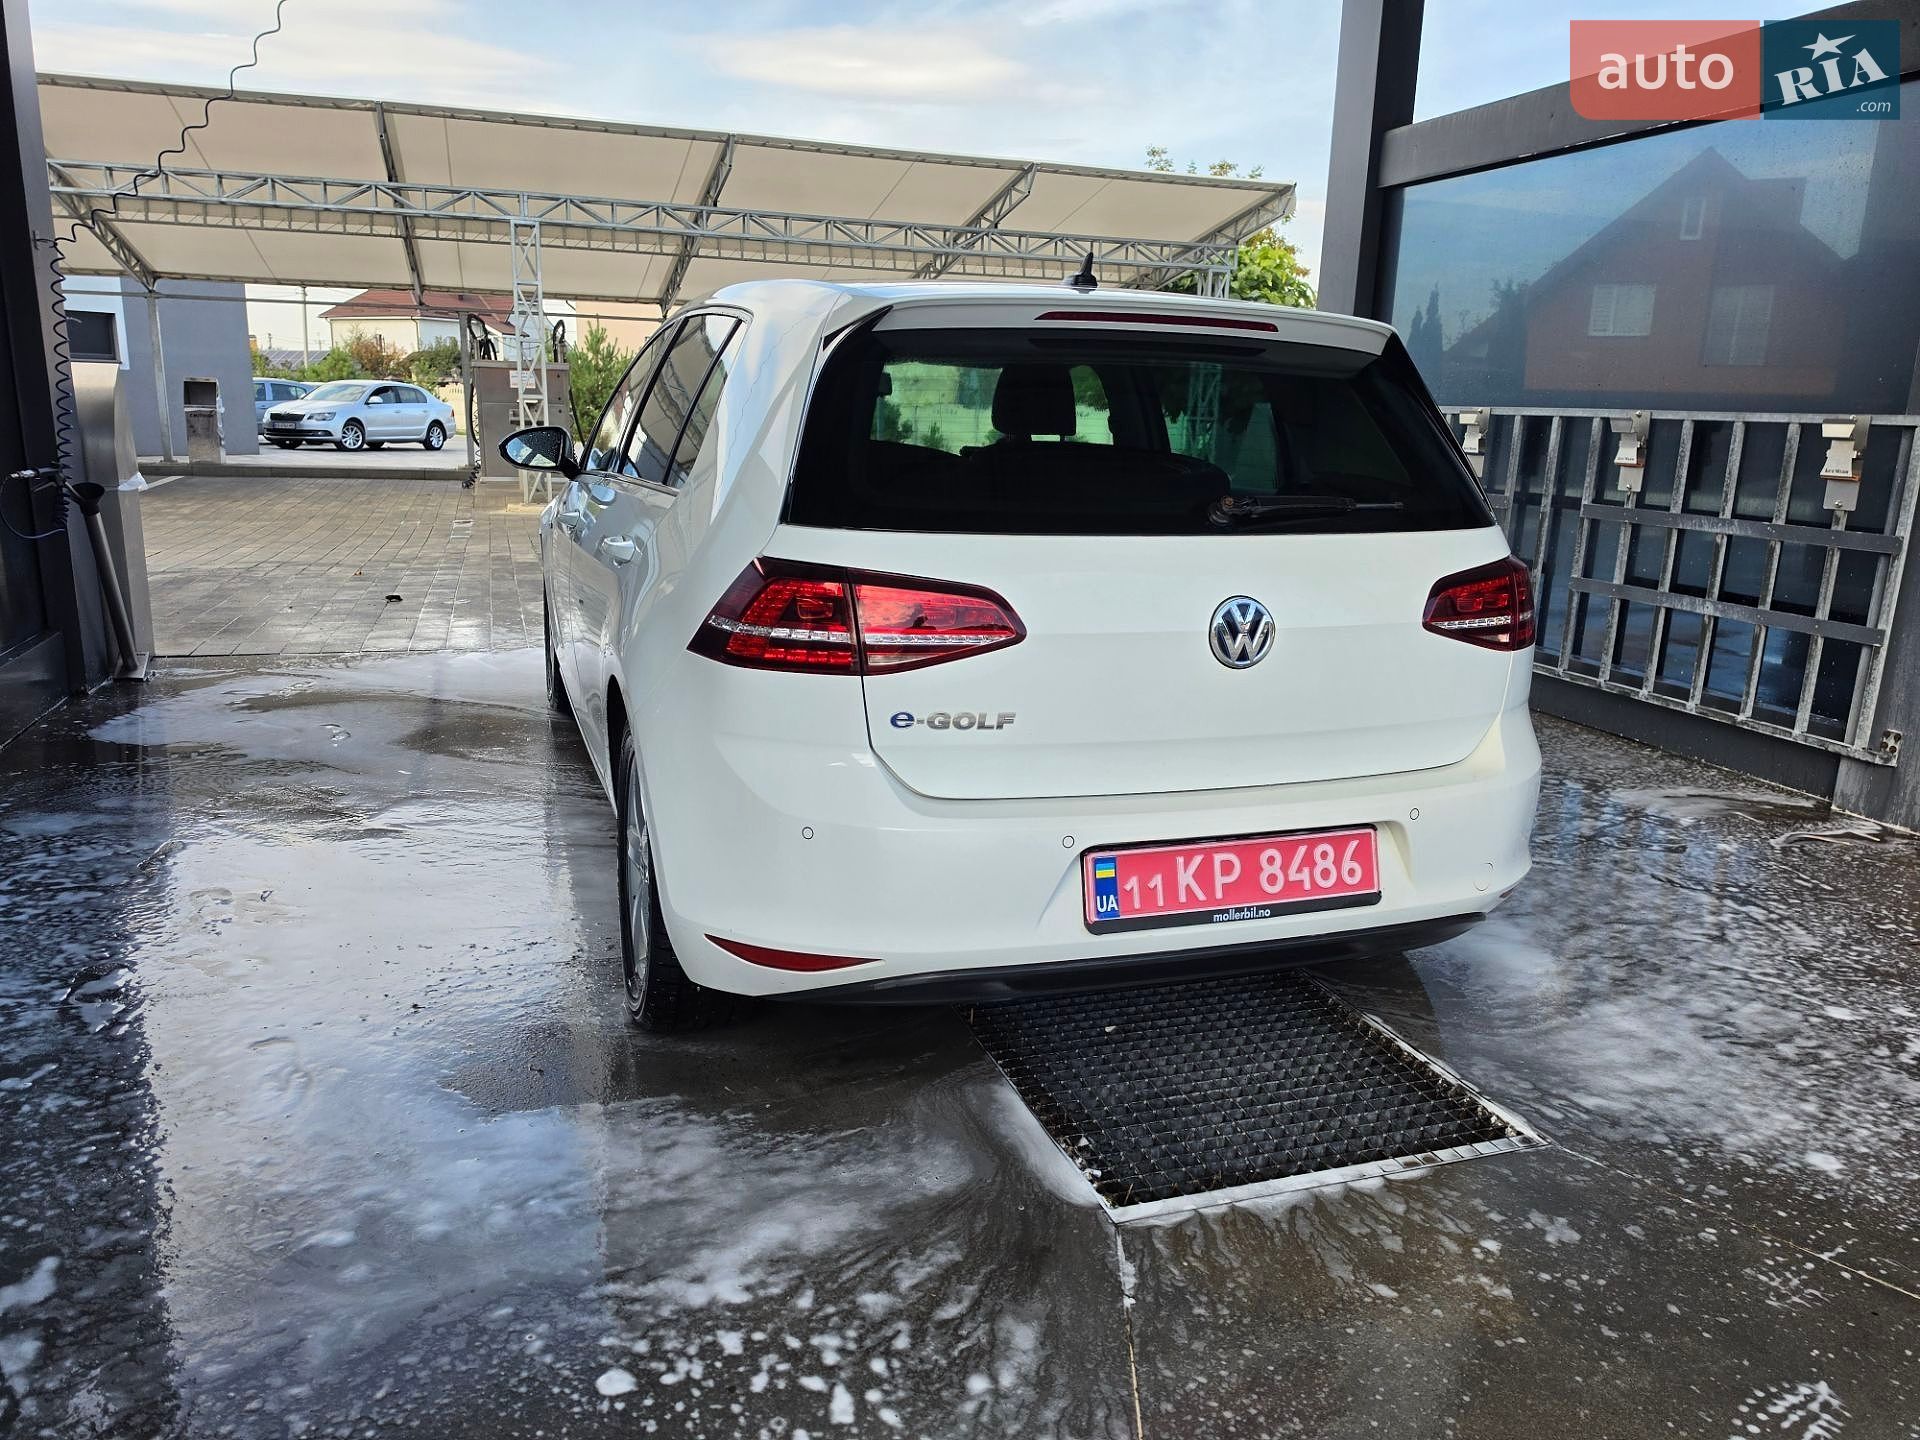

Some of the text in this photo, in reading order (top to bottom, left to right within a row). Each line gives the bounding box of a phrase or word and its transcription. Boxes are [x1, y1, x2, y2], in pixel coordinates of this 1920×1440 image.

[1211, 596, 1275, 669] VW
[890, 711, 1017, 731] e-GOLF
[1123, 840, 1363, 910] 11 KP 8486
[1096, 895, 1119, 913] UA
[1213, 907, 1271, 923] mollerbil.no
